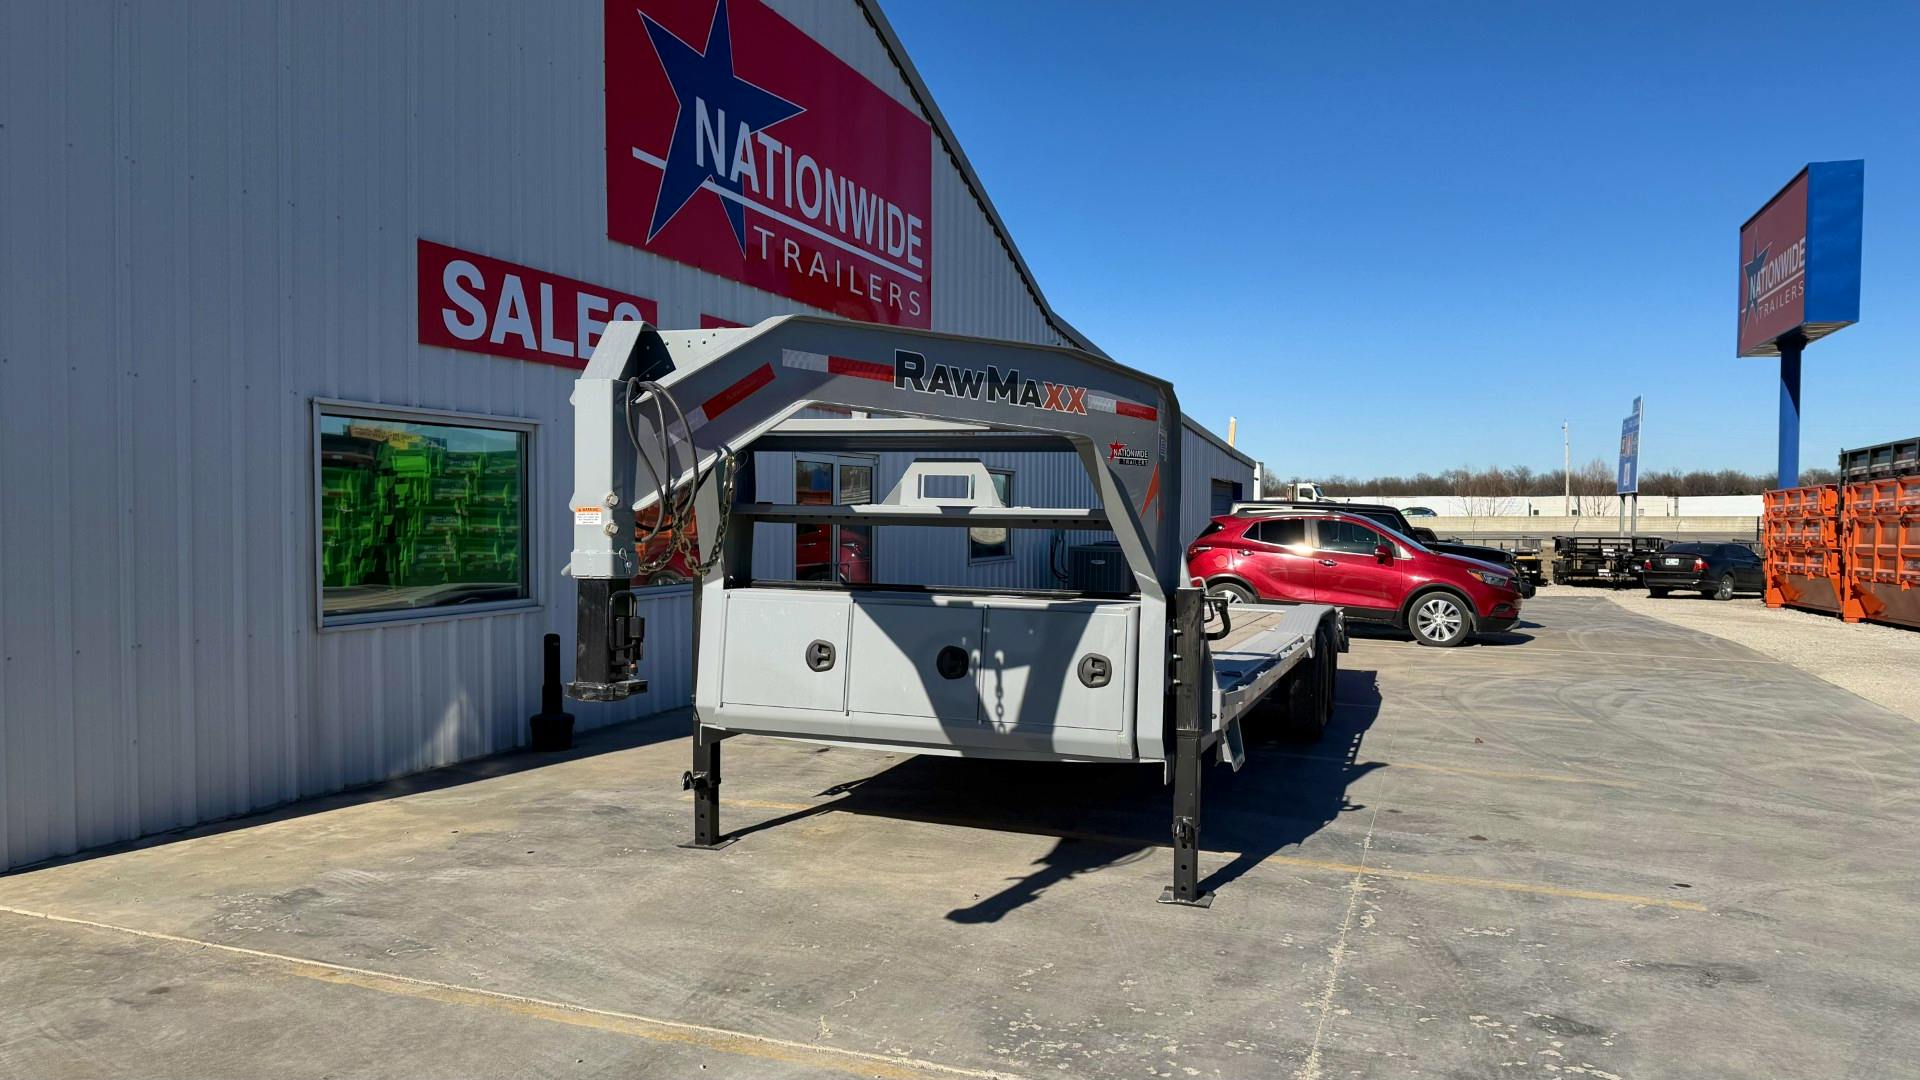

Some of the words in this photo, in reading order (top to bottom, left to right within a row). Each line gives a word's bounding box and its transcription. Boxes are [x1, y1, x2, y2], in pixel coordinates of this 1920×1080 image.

[696, 96, 923, 269] NATIONWIDE
[753, 225, 921, 316] TRAILERS
[1749, 236, 1806, 301] NATIONWIDE
[1759, 280, 1805, 319] TRAILERS
[1113, 448, 1149, 458] NATIONWIDE
